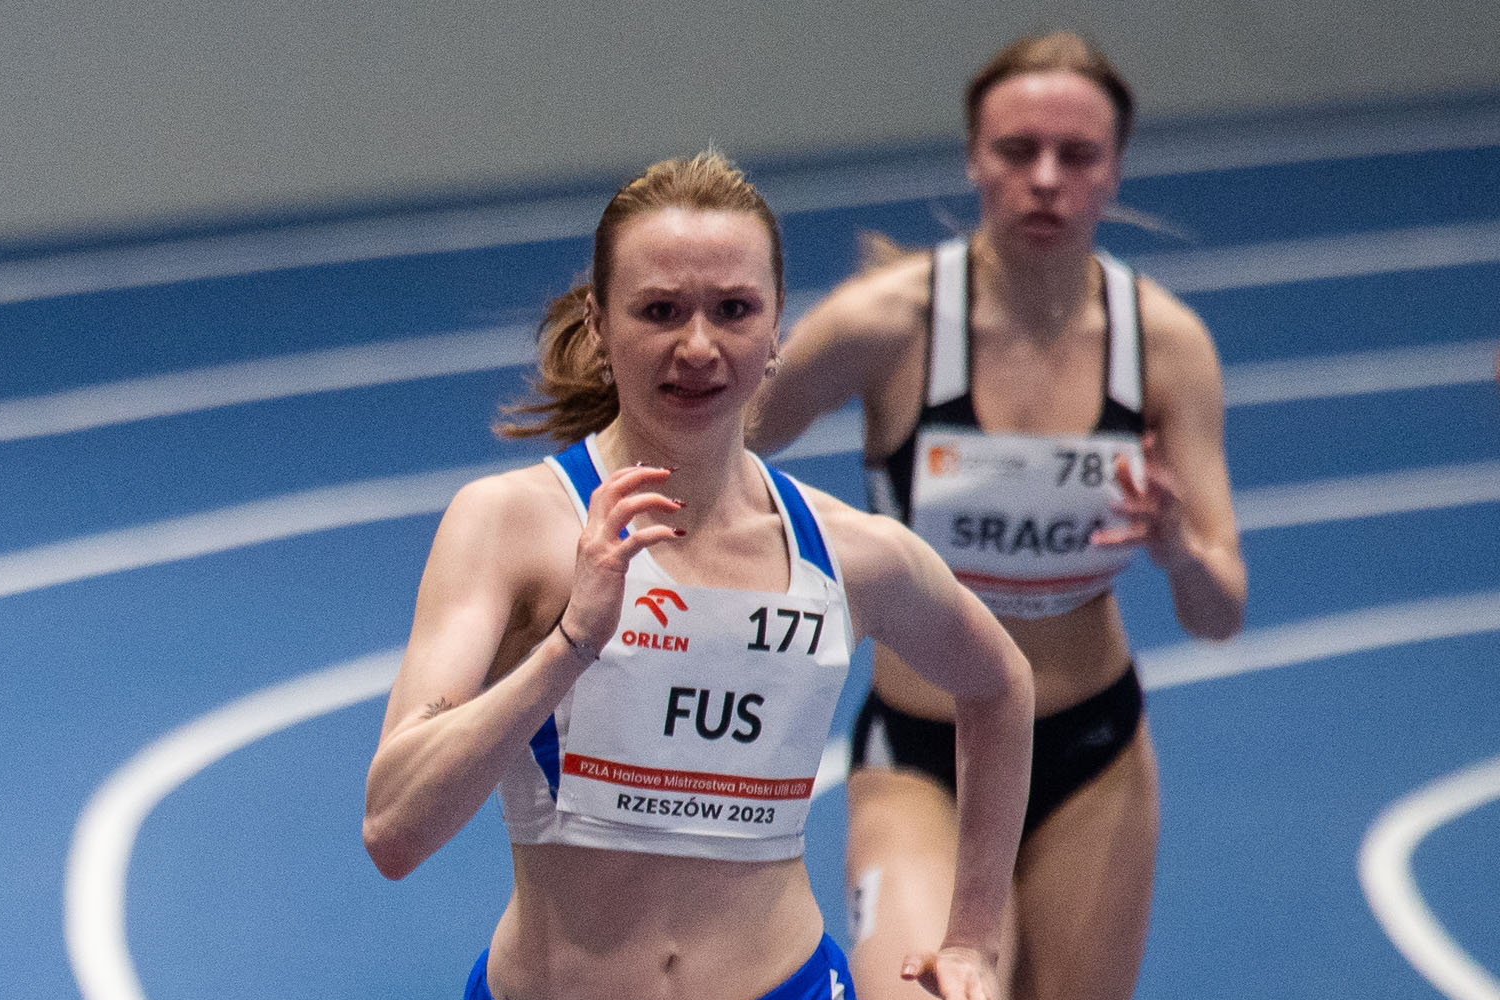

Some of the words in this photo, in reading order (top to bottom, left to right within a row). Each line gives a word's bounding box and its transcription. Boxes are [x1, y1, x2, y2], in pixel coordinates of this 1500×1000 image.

[1053, 451, 1120, 487] 78
[621, 629, 690, 653] ORLEN
[747, 606, 825, 656] 177
[662, 686, 766, 744] FUS
[579, 760, 610, 778] PZLA
[612, 768, 662, 787] Halowe
[663, 774, 737, 794] Mistrzostwa
[737, 782, 774, 796] Polski
[616, 792, 723, 821] RZESZÓW
[726, 804, 776, 825] 2023
